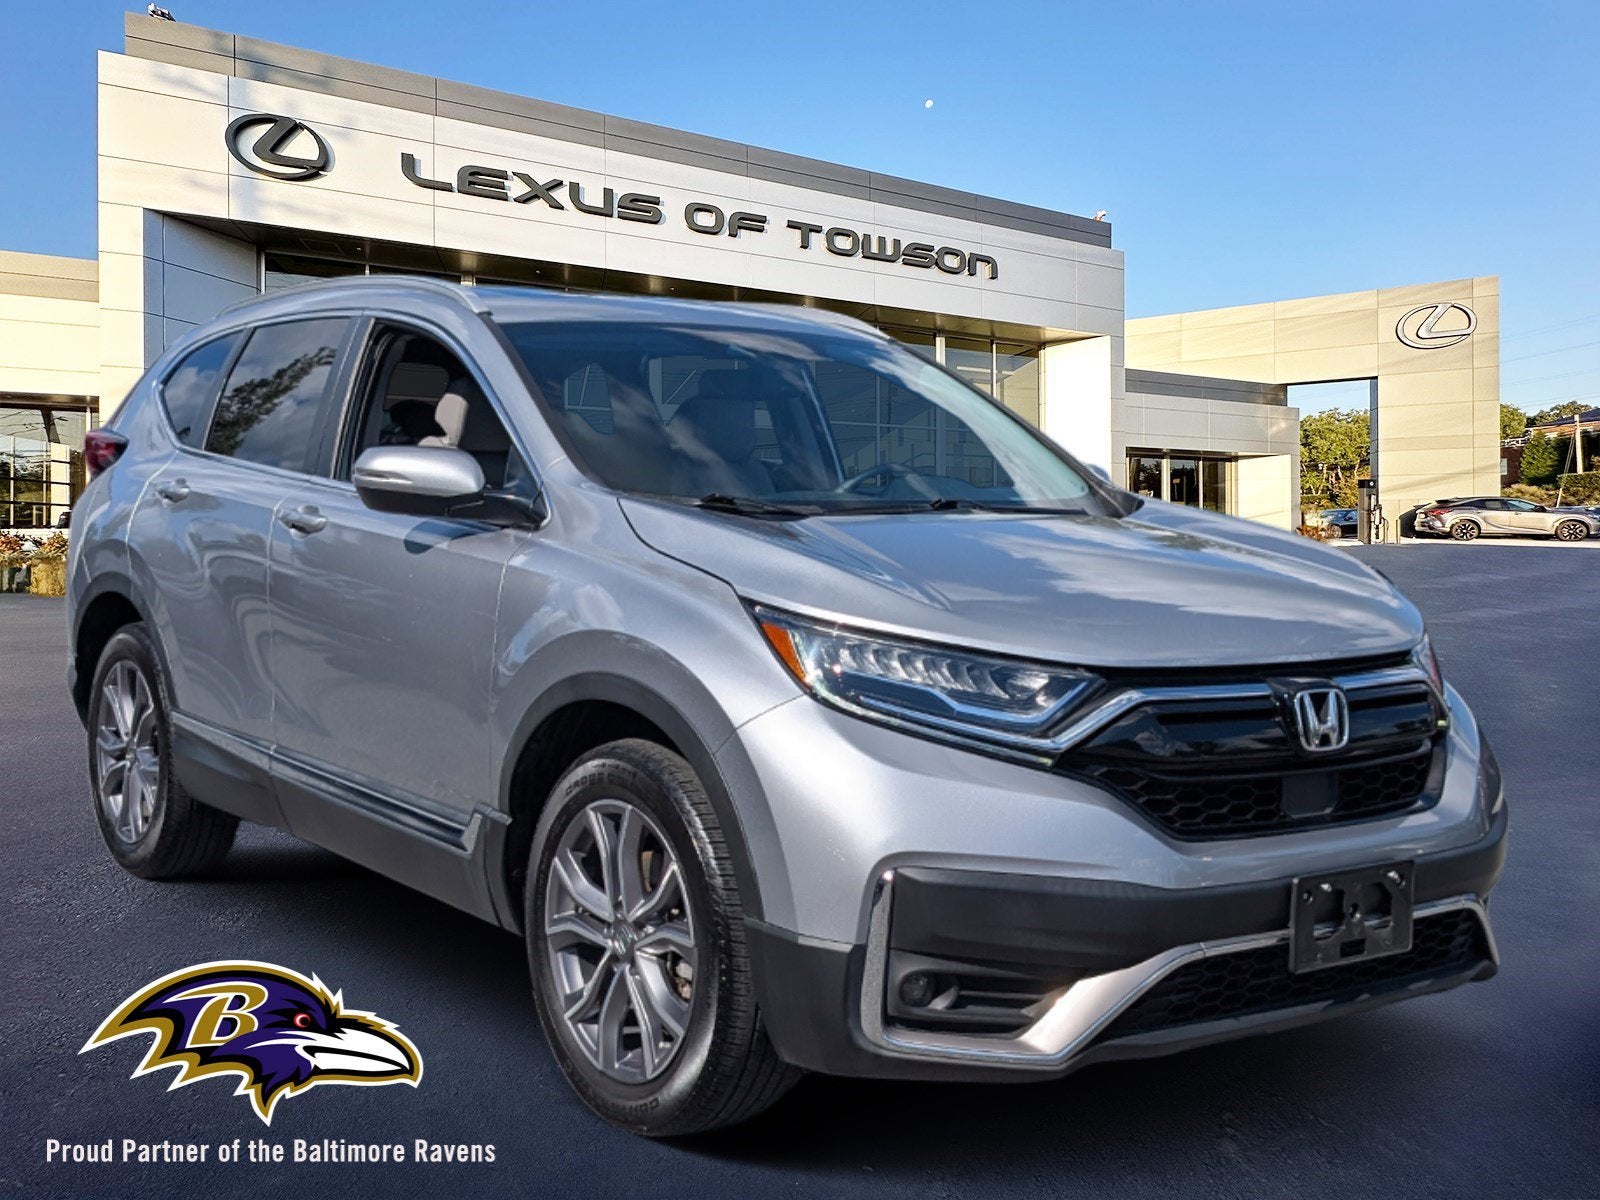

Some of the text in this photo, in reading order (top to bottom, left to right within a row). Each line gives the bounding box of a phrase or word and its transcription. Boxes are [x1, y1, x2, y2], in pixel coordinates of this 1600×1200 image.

[401, 152, 998, 280] LEXUS OF TOWSON
